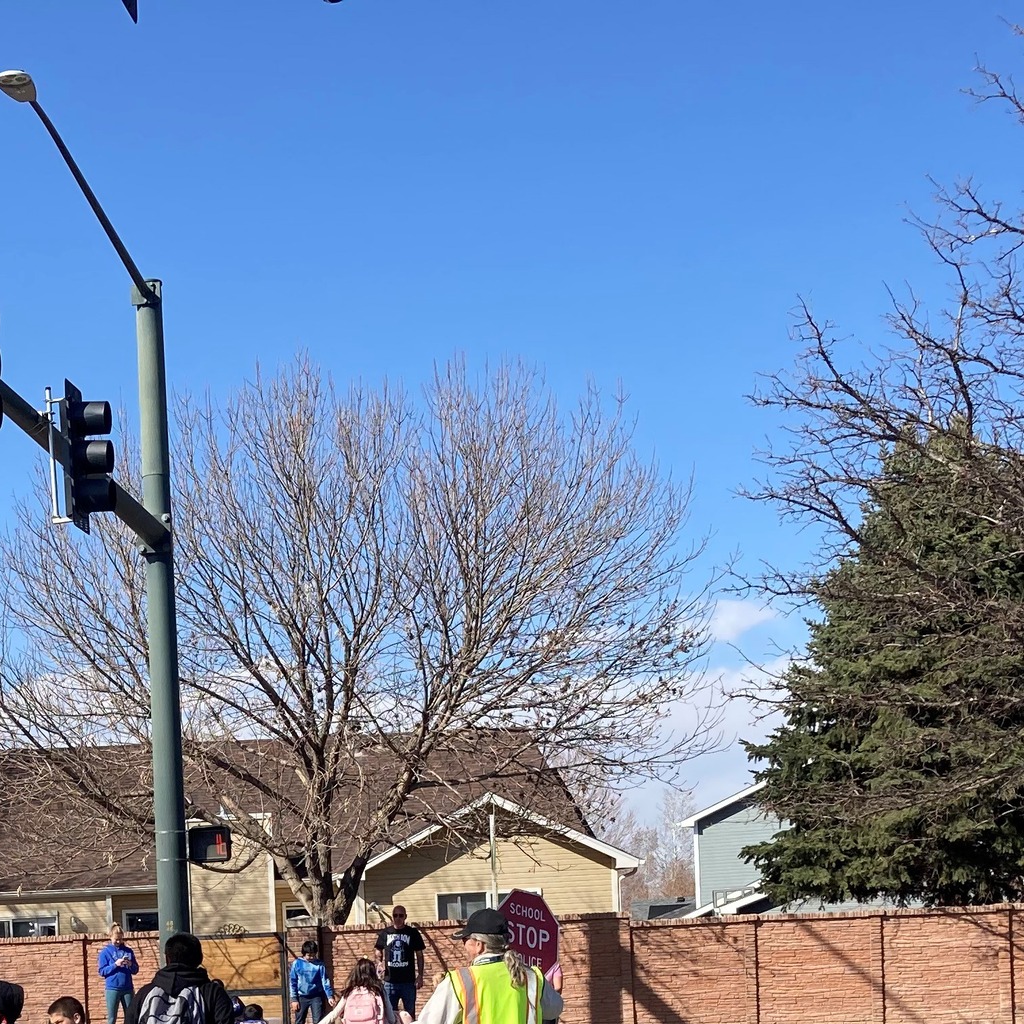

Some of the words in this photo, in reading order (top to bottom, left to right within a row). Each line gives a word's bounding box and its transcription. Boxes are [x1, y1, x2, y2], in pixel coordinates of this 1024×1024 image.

[509, 902, 546, 922] SCHOOL
[508, 921, 550, 950] STOP
[516, 953, 542, 970] OLICE
